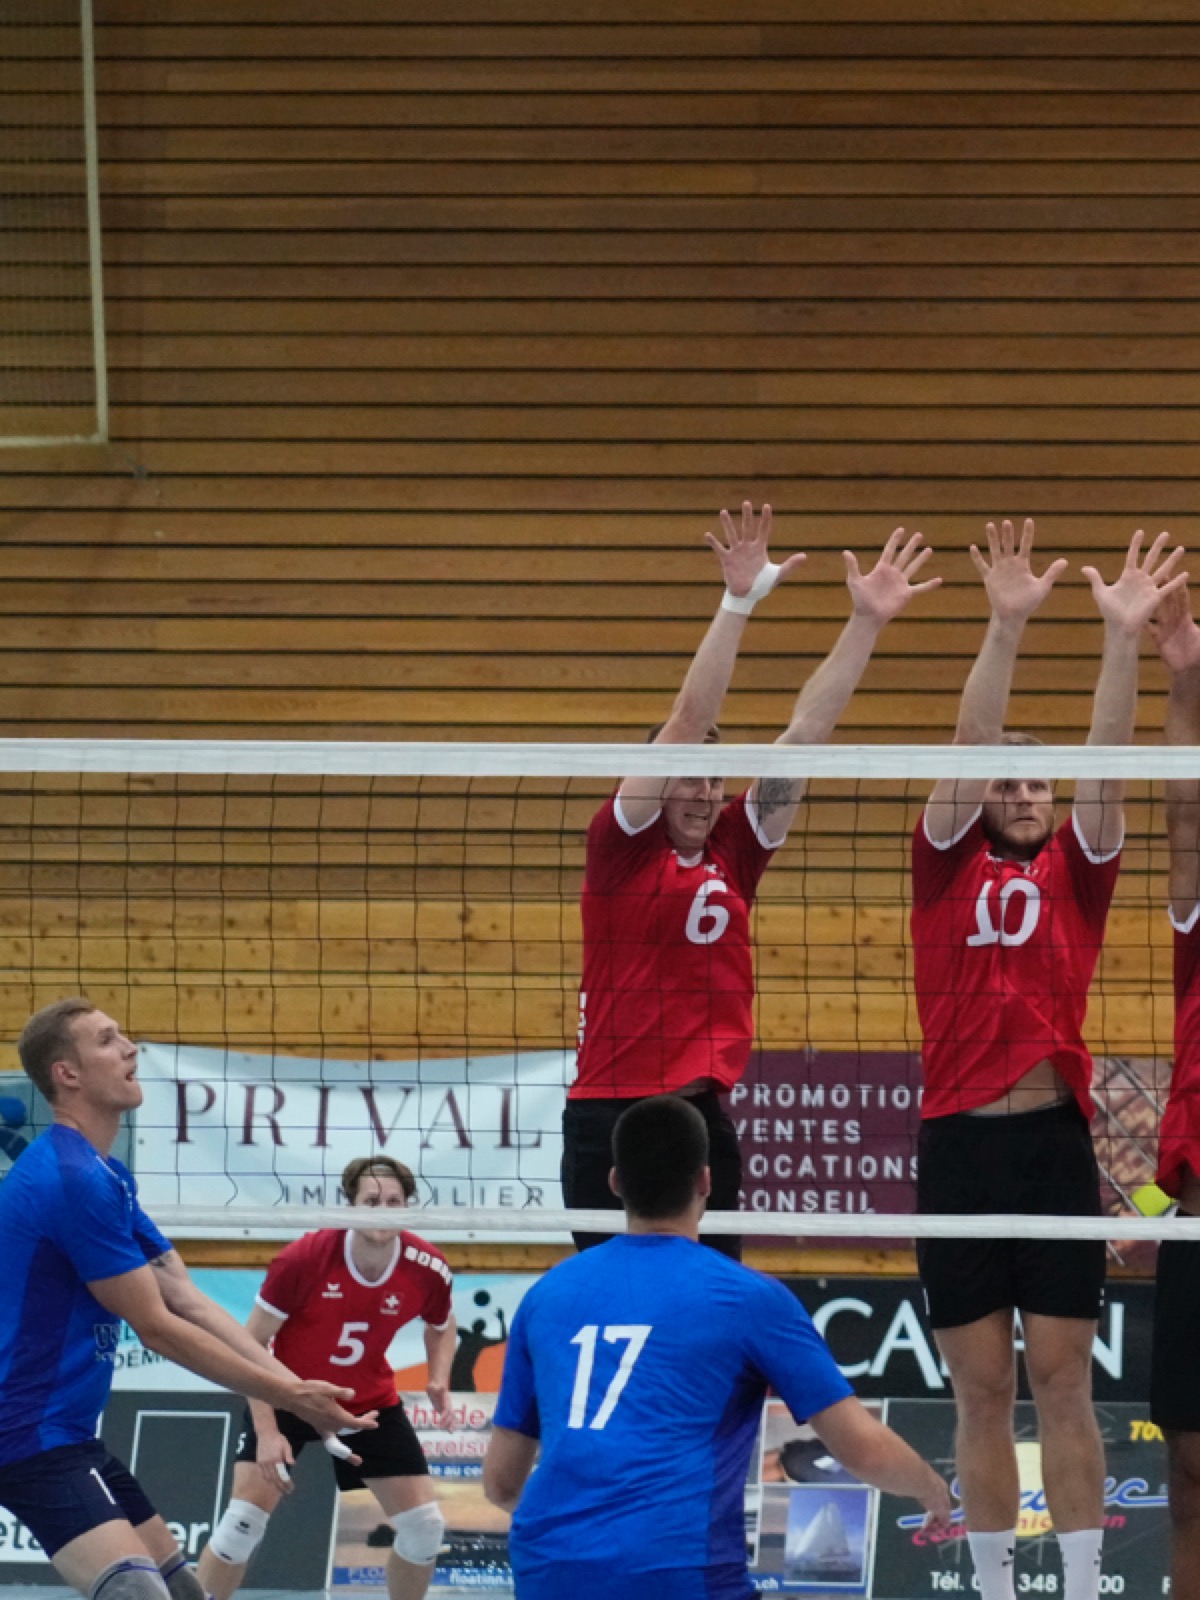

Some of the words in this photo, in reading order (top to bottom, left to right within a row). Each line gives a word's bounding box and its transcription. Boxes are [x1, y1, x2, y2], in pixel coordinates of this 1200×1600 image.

[685, 879, 730, 945] 6
[965, 877, 1041, 947] 10
[171, 1079, 544, 1149] PRIVAL
[730, 1084, 924, 1110] PROMOTIO
[329, 1321, 370, 1367] 5
[567, 1324, 654, 1430] 17
[931, 1571, 964, 1591] Tél.
[1018, 1574, 1057, 1592] 348
